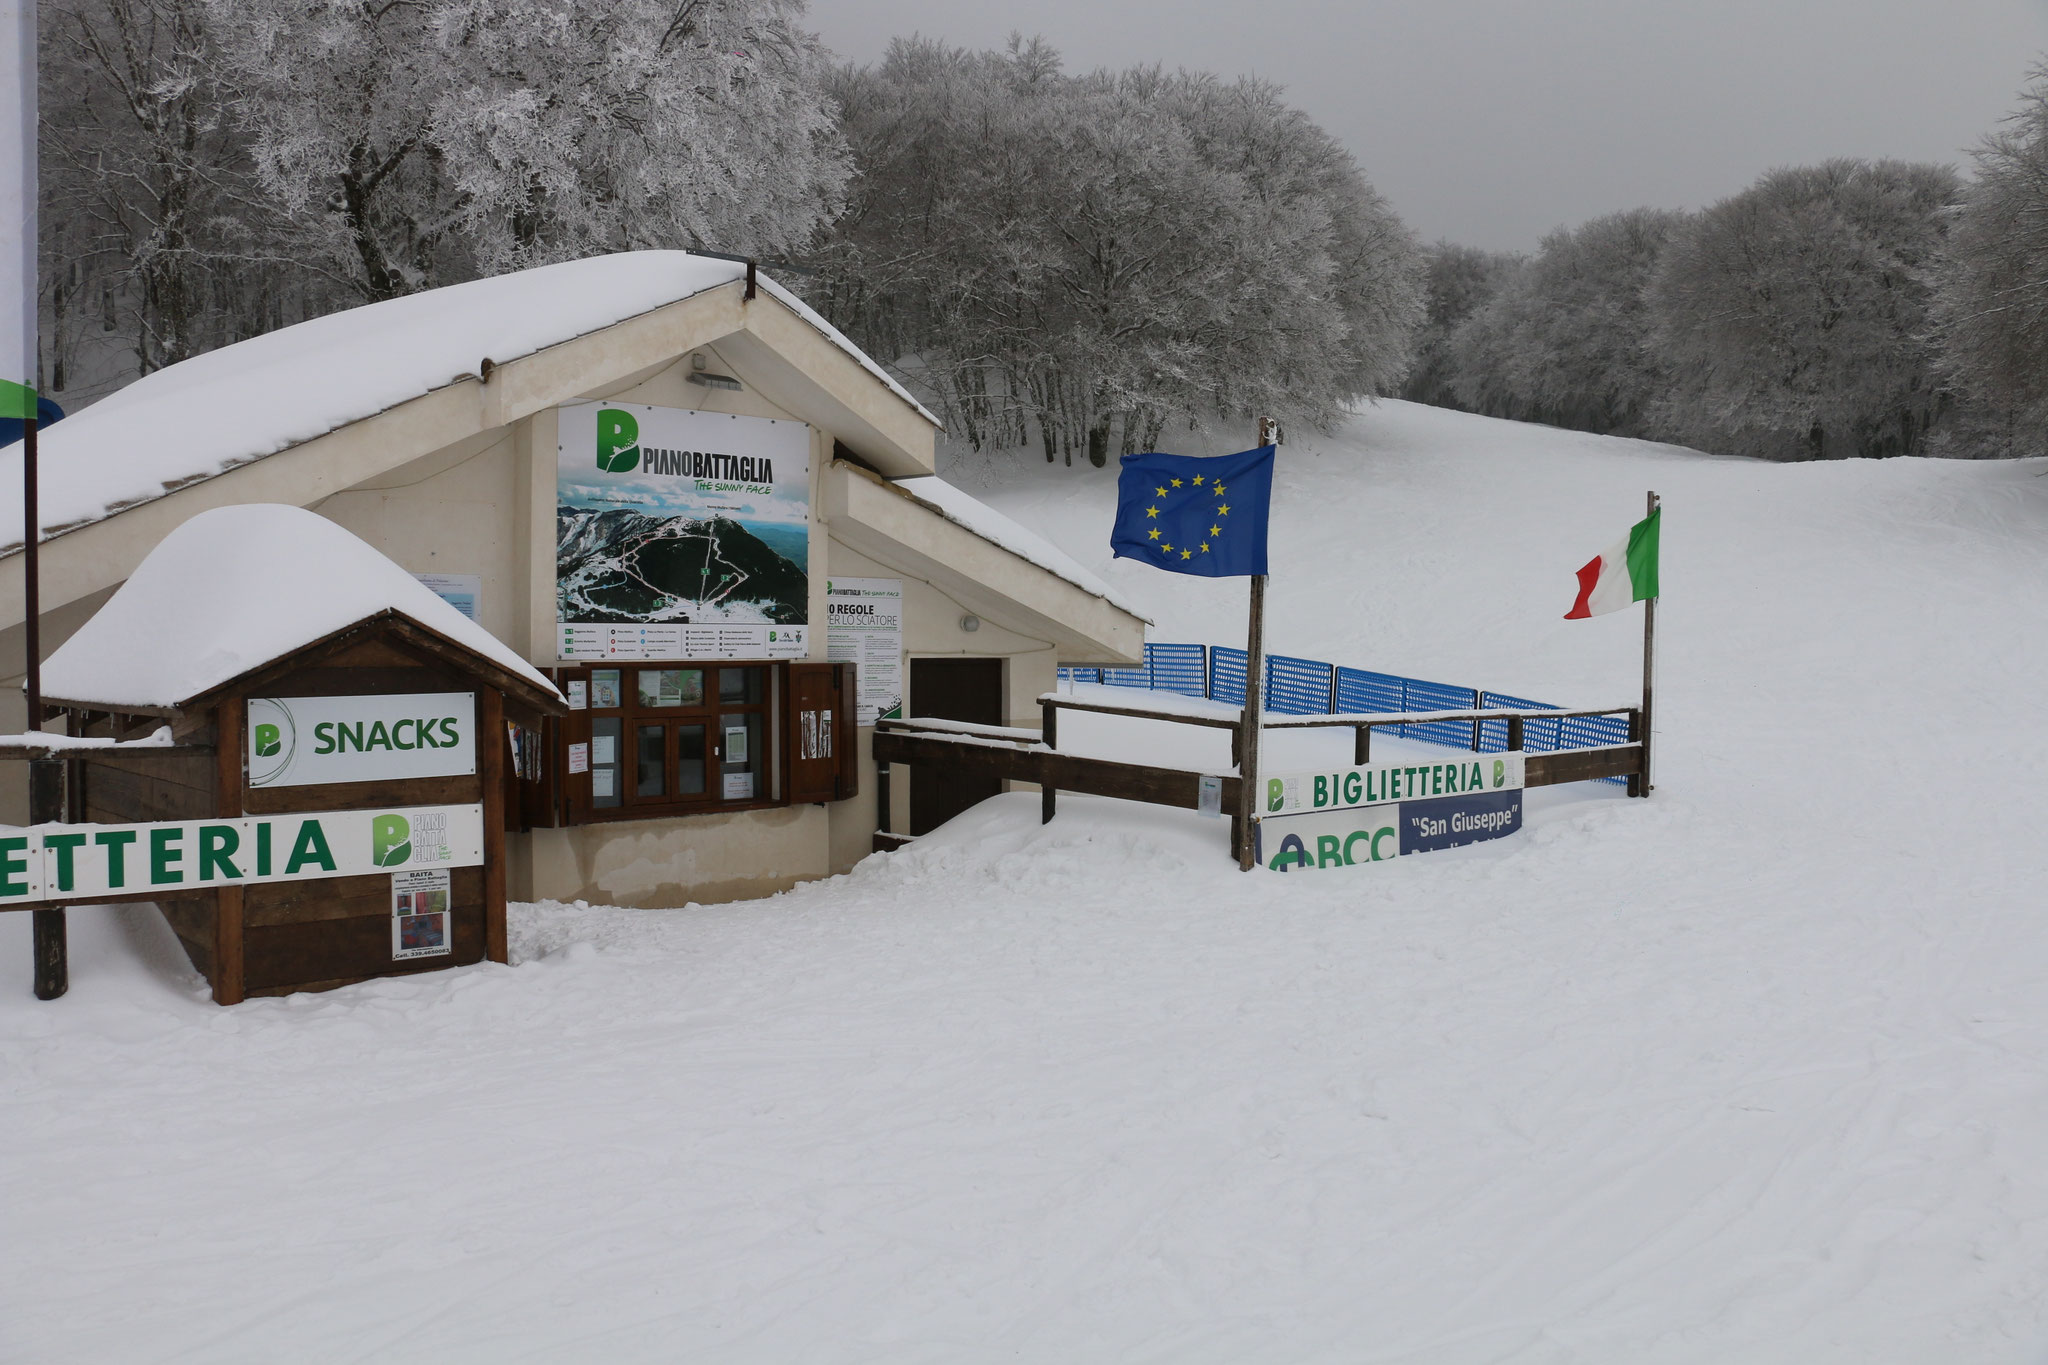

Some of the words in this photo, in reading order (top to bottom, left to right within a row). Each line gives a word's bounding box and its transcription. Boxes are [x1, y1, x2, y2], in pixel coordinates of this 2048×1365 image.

[694, 479, 713, 491] THE
[714, 483, 744, 493] SUNNY
[745, 485, 772, 495] FACE
[837, 604, 874, 615] REGOLE
[843, 615, 855, 625] LO
[856, 615, 898, 626] SCIATORE
[314, 717, 460, 755] SNACKS
[1313, 762, 1484, 808] BIGLIETTERIA
[414, 812, 447, 830] PIANO
[414, 829, 447, 847] BATTA
